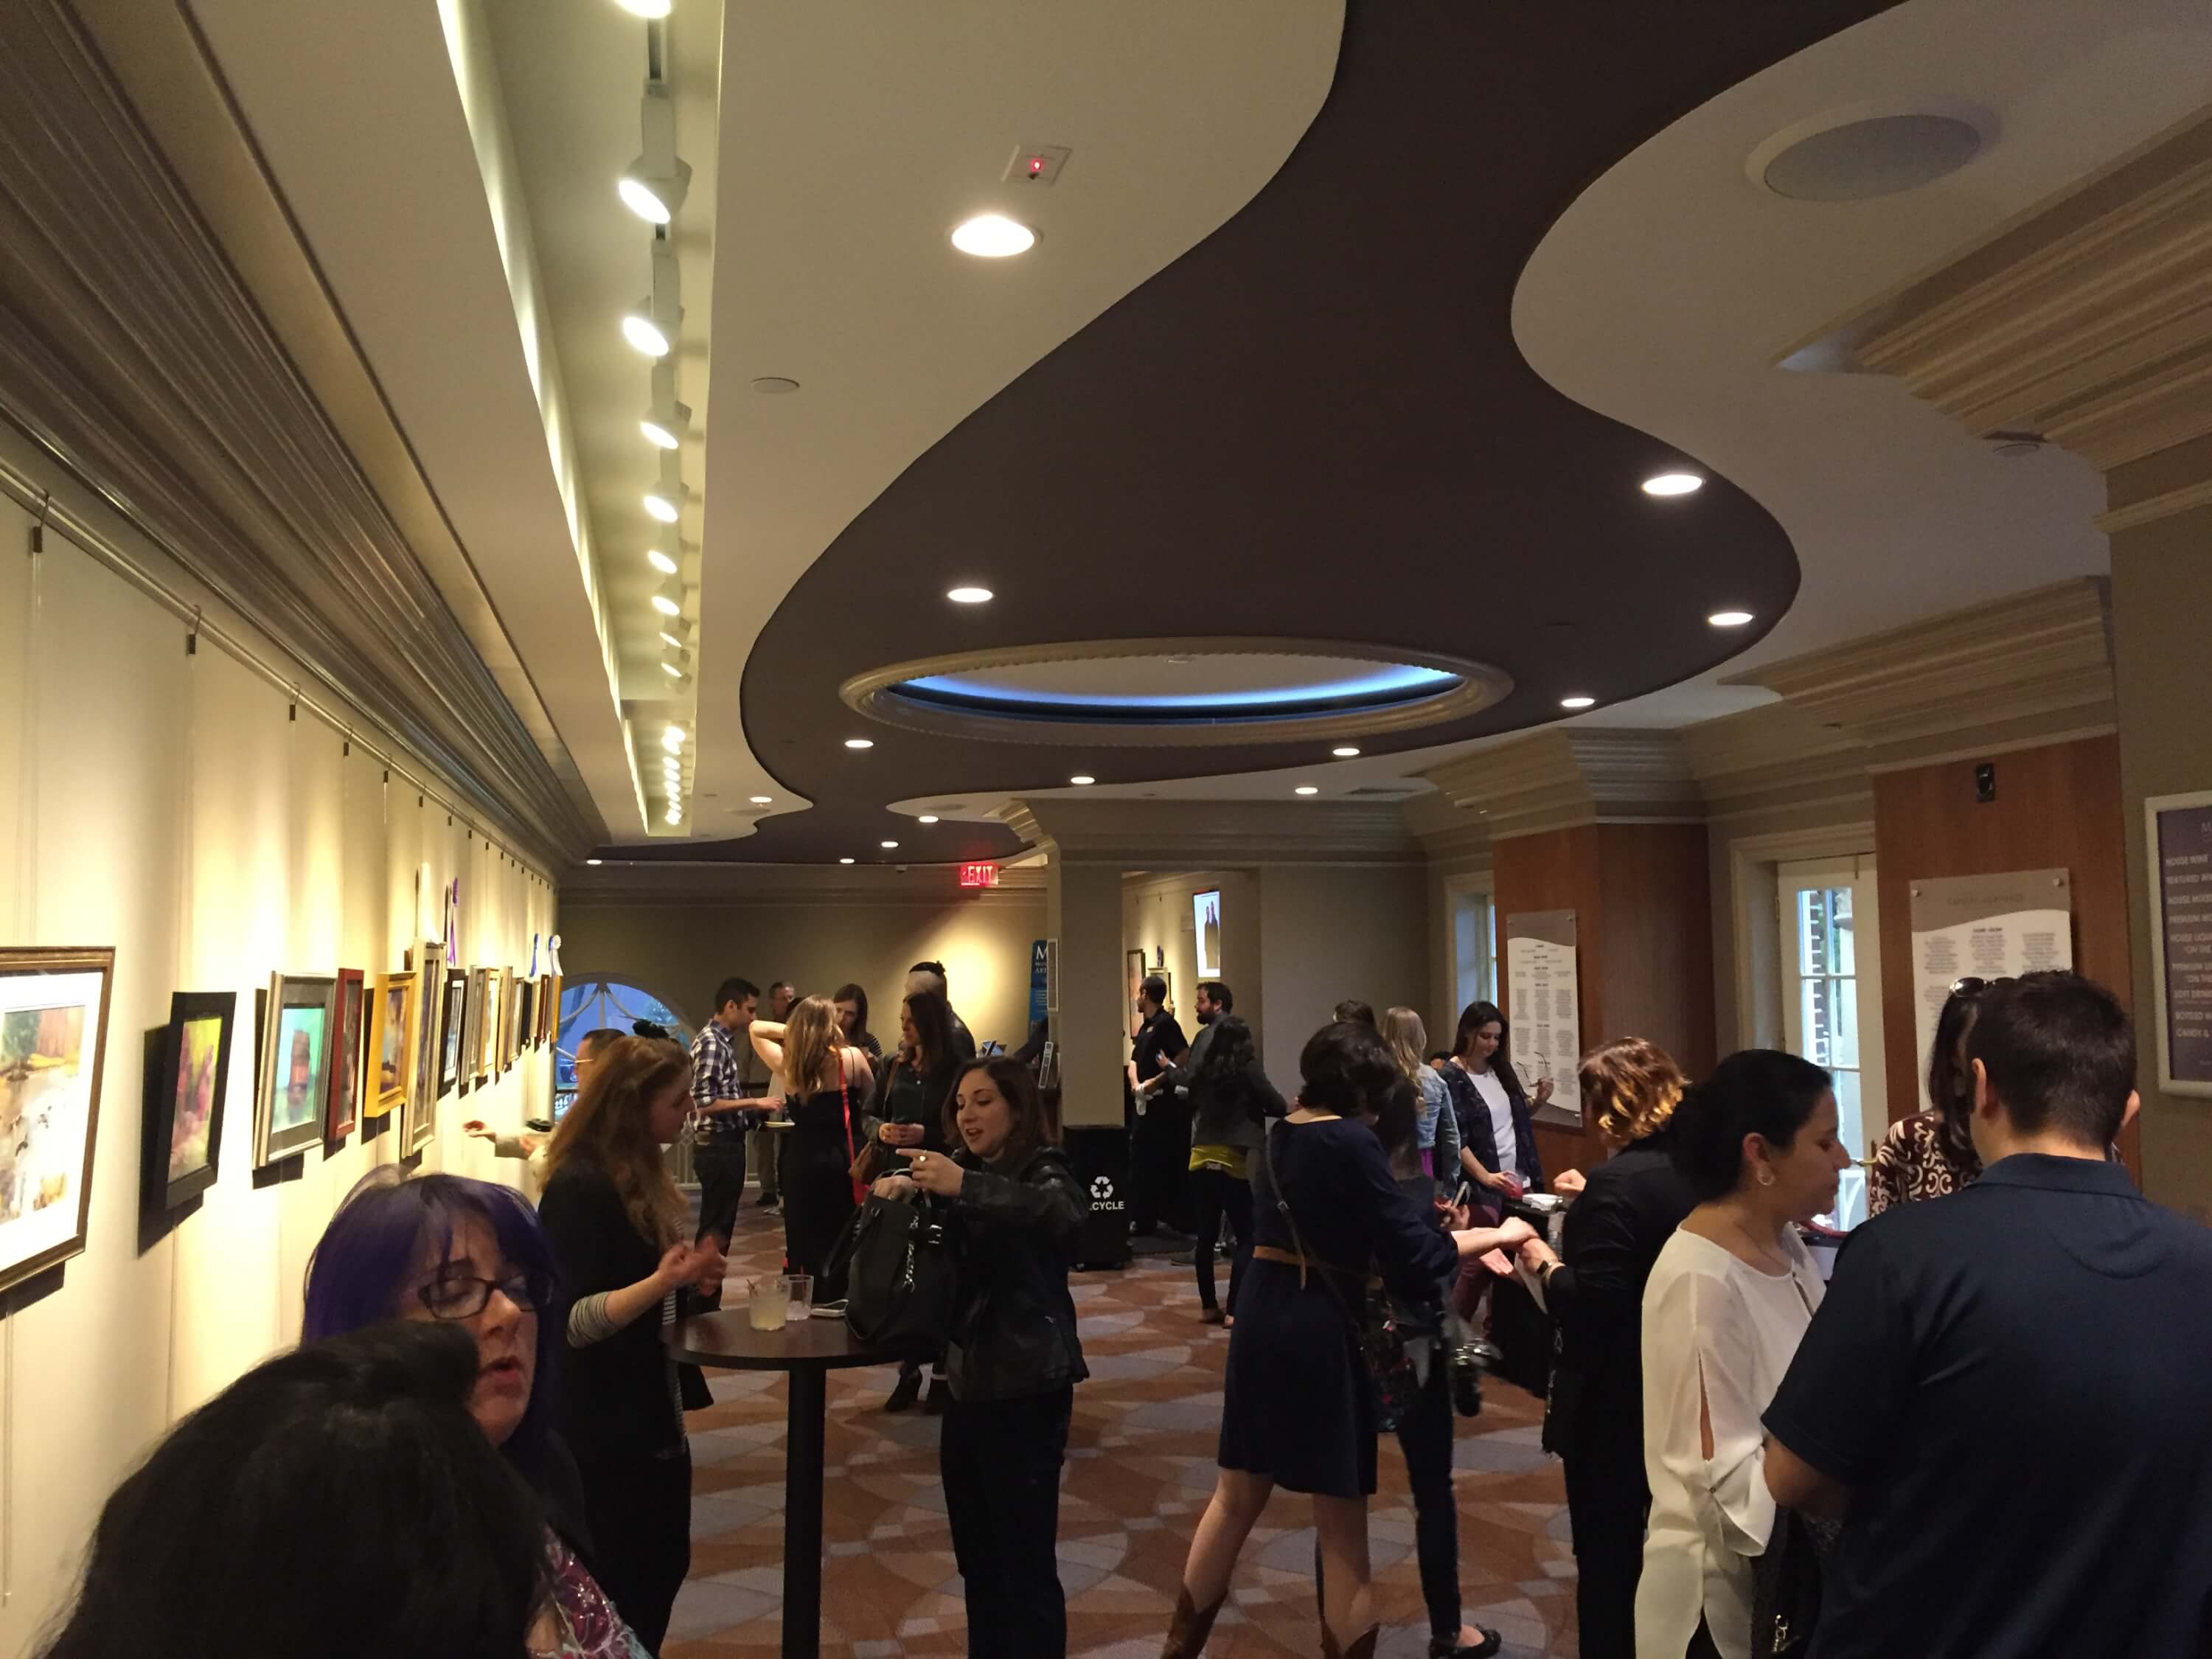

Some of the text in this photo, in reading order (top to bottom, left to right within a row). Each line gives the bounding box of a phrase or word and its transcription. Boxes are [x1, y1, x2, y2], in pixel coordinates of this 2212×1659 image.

[2189, 855, 2208, 863] WINE
[967, 865, 993, 883] EXIT
[1089, 1201, 1124, 1211] CYCLE
